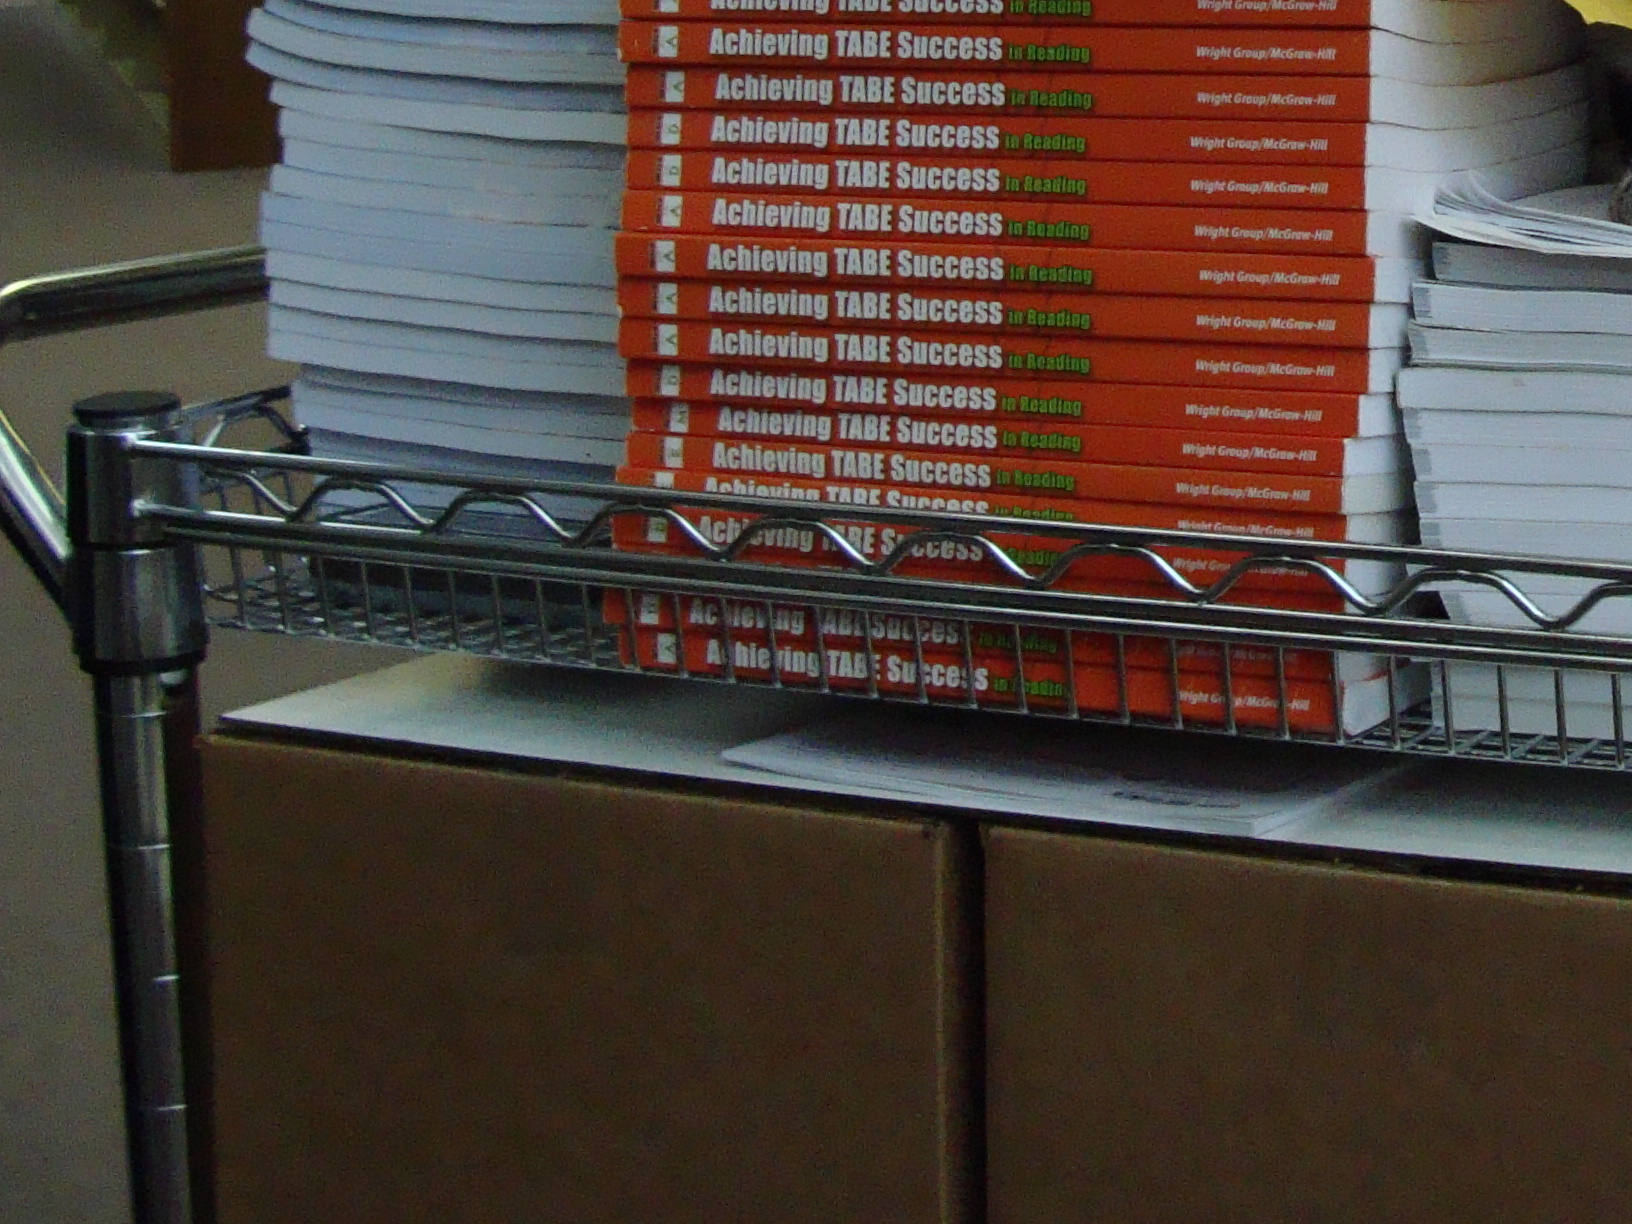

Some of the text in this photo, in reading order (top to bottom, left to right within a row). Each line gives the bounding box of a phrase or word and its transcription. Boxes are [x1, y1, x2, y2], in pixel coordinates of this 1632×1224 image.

[708, 27, 1090, 64] Achieving TABE Success in Reading
[1196, 46, 1337, 60] Wright Group/McGraw-Hill
[714, 73, 1092, 109] Achieving TABE Success in Reading
[1197, 92, 1336, 107] Wright Group/McGraw-Hill
[709, 115, 1085, 153] Achieving TABE Success in Reading
[1190, 136, 1328, 151] Wright Group/McGraw-Hill
[710, 156, 1086, 195] Achieving TABE Success in Reading
[1190, 179, 1328, 194] Wright Group/McGraw-Hill
[711, 198, 1090, 241] Achieving TABE Success in Reading
[1194, 225, 1333, 241] Wright Group/McGraw-Hill
[706, 243, 1092, 285] Achieving TABE Success in Reading
[1199, 270, 1340, 286] Wright Group/McGraw-Hill
[707, 286, 1090, 329] Achieving TABE Success in Reading
[1196, 315, 1336, 331] Wright Group/McGraw-Hill
[708, 327, 1090, 374] Achieving TABE Success in Reading
[1195, 359, 1335, 376] Wright Group/McGraw-Hill
[708, 369, 1082, 416] Achieving TABE Success in Reading
[1185, 404, 1322, 421] Wright Group/McGraw-Hill
[718, 407, 1081, 451] Achieving TABE Success in Reading
[713, 441, 1075, 489] Achieving TABE Success in Reading
[1182, 443, 1317, 461] Wright Group/McGraw-Hill
[1176, 483, 1310, 501] Wright Group/McGraw-Hill
